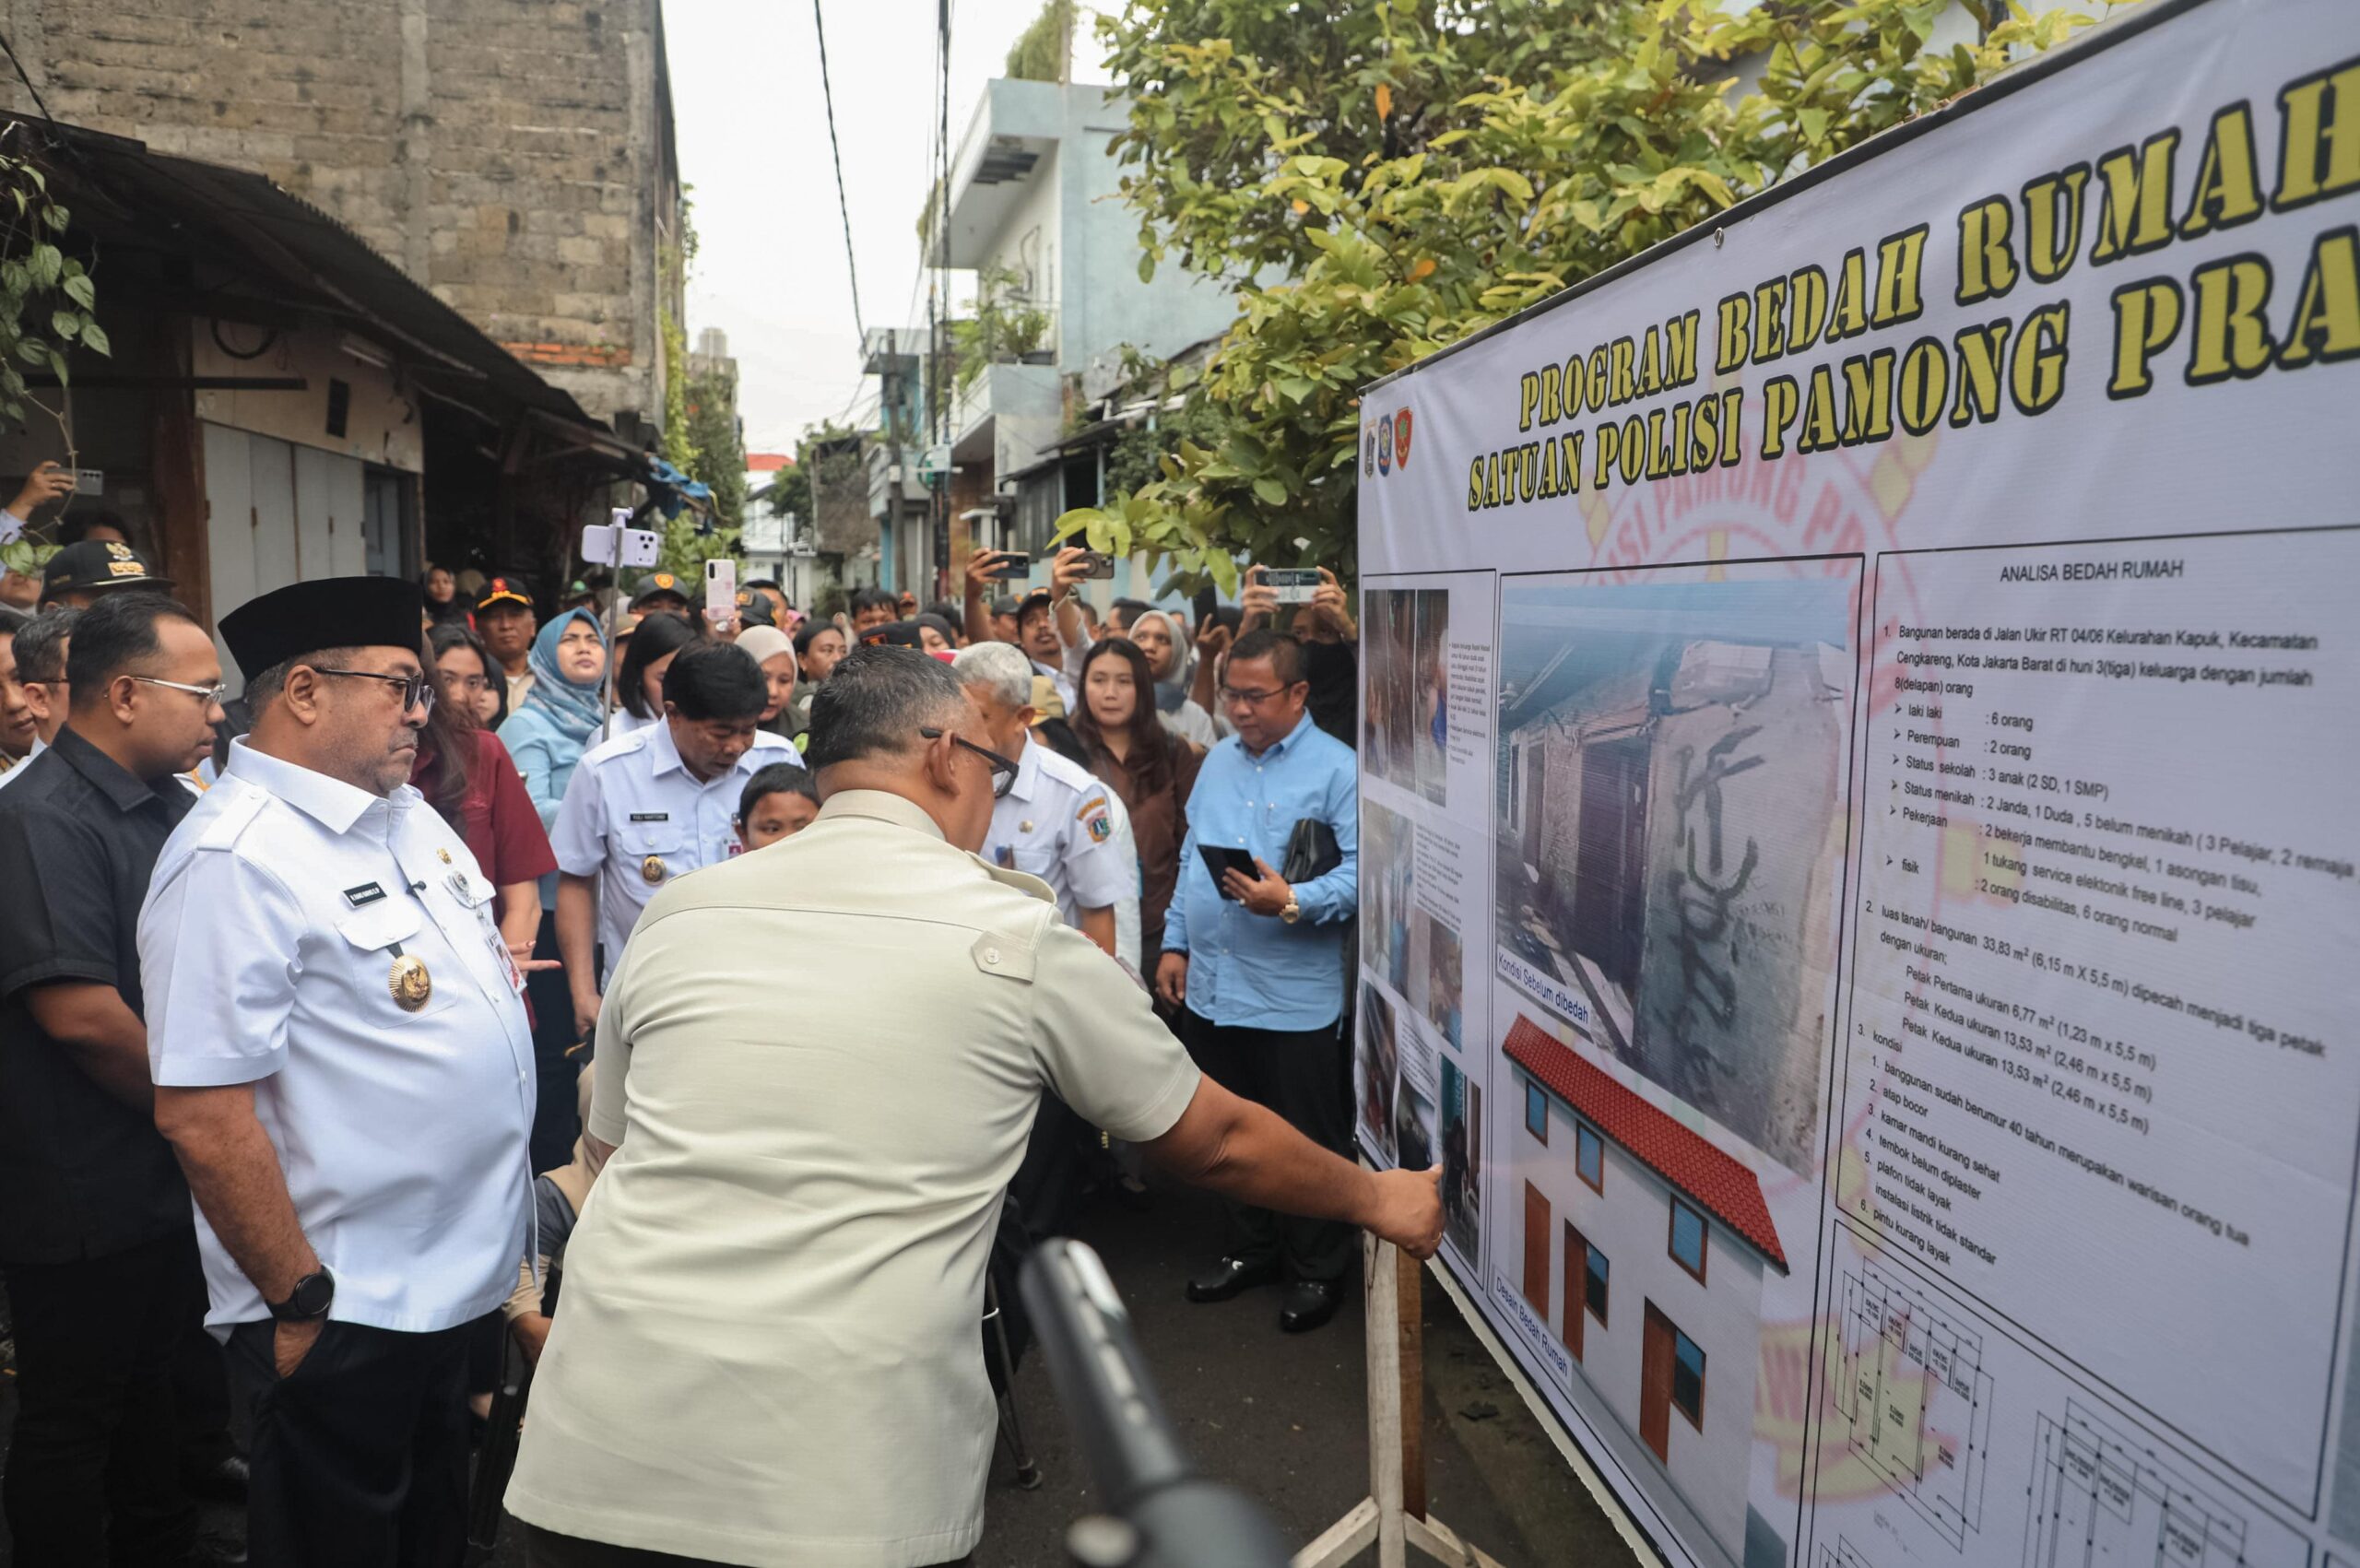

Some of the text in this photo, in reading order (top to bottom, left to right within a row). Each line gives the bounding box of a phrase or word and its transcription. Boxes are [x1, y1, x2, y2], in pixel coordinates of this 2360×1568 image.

[1519, 57, 2360, 432] PROGRAM BEDAH RUMAH
[1469, 429, 1584, 513] SATUAN
[1594, 387, 1744, 491] POLISI
[1761, 299, 2071, 460] PAMONG
[2000, 559, 2184, 582] ANALISA BEDAH RUMAH
[1883, 625, 2319, 650] 1. Bangunan berada di Jalan Ukir RT 04/06 Kelurahan Kapuk, Kecamatan
[1897, 651, 2313, 688] Cengkareng, Kota Jakarta Barat di huni 3(tiga) keluarga dengan jumlah
[1894, 677, 1973, 698] 8(delapan) orang
[1908, 704, 2033, 732] laki laki 6 orang
[1906, 755, 2109, 802] Status sekolah 3 anak (2 SD, SMP)
[1907, 729, 2031, 760] Perempuan 2 orang
[1903, 807, 2226, 888] Pekerjaan 2 bekerja membantu bengkel, asongan
[1904, 781, 1932, 797] Status
[1935, 788, 1974, 806] menikah
[1987, 796, 1994, 809] 2
[1996, 798, 2031, 819] Janda,
[2044, 806, 2073, 824] Duda
[2084, 814, 2093, 827] 5
[2095, 815, 2133, 835] belum
[2136, 824, 2193, 846] menikah
[1902, 859, 2178, 943] fisik 2 orang disabilitas, 6 orang normal
[1984, 852, 1989, 865] 1
[1992, 854, 2027, 877] tukang
[2033, 864, 2072, 884] service
[2132, 886, 2157, 904] free
[2204, 903, 2257, 929] pelajar
[1881, 931, 1911, 953] dengan
[1498, 953, 1588, 1024] Kondisi Sebelum dibedah
[1866, 901, 1873, 914] 2.
[1882, 904, 1899, 921] luas
[1931, 919, 1977, 947] bangunan
[1983, 937, 2011, 961] 33,83
[2091, 968, 2109, 989] 5,5
[2131, 984, 2183, 1013] dipecah
[2186, 1002, 2244, 1032] menjadi
[2248, 1019, 2275, 1043] tiga
[2280, 1032, 2326, 1058] petak
[1906, 966, 1931, 986] Petak
[1934, 975, 1973, 1001] Pertama
[1976, 992, 2010, 1015] ukuran
[2012, 1005, 2036, 1023] 6,77
[2115, 1042, 2135, 1061] 5,5
[1858, 1024, 1903, 1054] 3. kondisi
[1902, 1017, 1927, 1038] Petak
[1932, 1031, 1962, 1054] Kedua
[1965, 1046, 1998, 1069] ukuran
[2001, 1061, 2030, 1082] 13,53
[2108, 1104, 2129, 1124] 5,5
[1905, 991, 1929, 1012] Petak
[1935, 1003, 1964, 1026] Kedua
[1966, 1018, 2000, 1041] ukuran
[2004, 1031, 2033, 1055] 13,53
[2112, 1073, 2132, 1092] 5,5
[1870, 1079, 1929, 1117] 2. atap bocor
[1866, 1127, 1981, 1199] 4. tembok belum diplaster
[1868, 1102, 2000, 1184] 3. kamar mandi kurang sehat
[1872, 1055, 1879, 1069] 1.
[1884, 1060, 1933, 1093] banggunan
[1935, 1085, 1968, 1106] sudah
[1965, 1099, 2008, 1128] berumur
[2009, 1120, 2022, 1137] 40
[2024, 1126, 2056, 1153] tahun
[2058, 1145, 2124, 1185] merupakan
[2127, 1177, 2178, 1212] warisan
[2181, 1204, 2222, 1236] orang
[1865, 1151, 1952, 1212] 5. plafon tidak layak
[1860, 1199, 1951, 1265] 6. pintu kurang layak
[1875, 1182, 1997, 1266] instalasi listrik tidak standar
[1497, 1277, 1567, 1376] Desain Bedah Rumah
